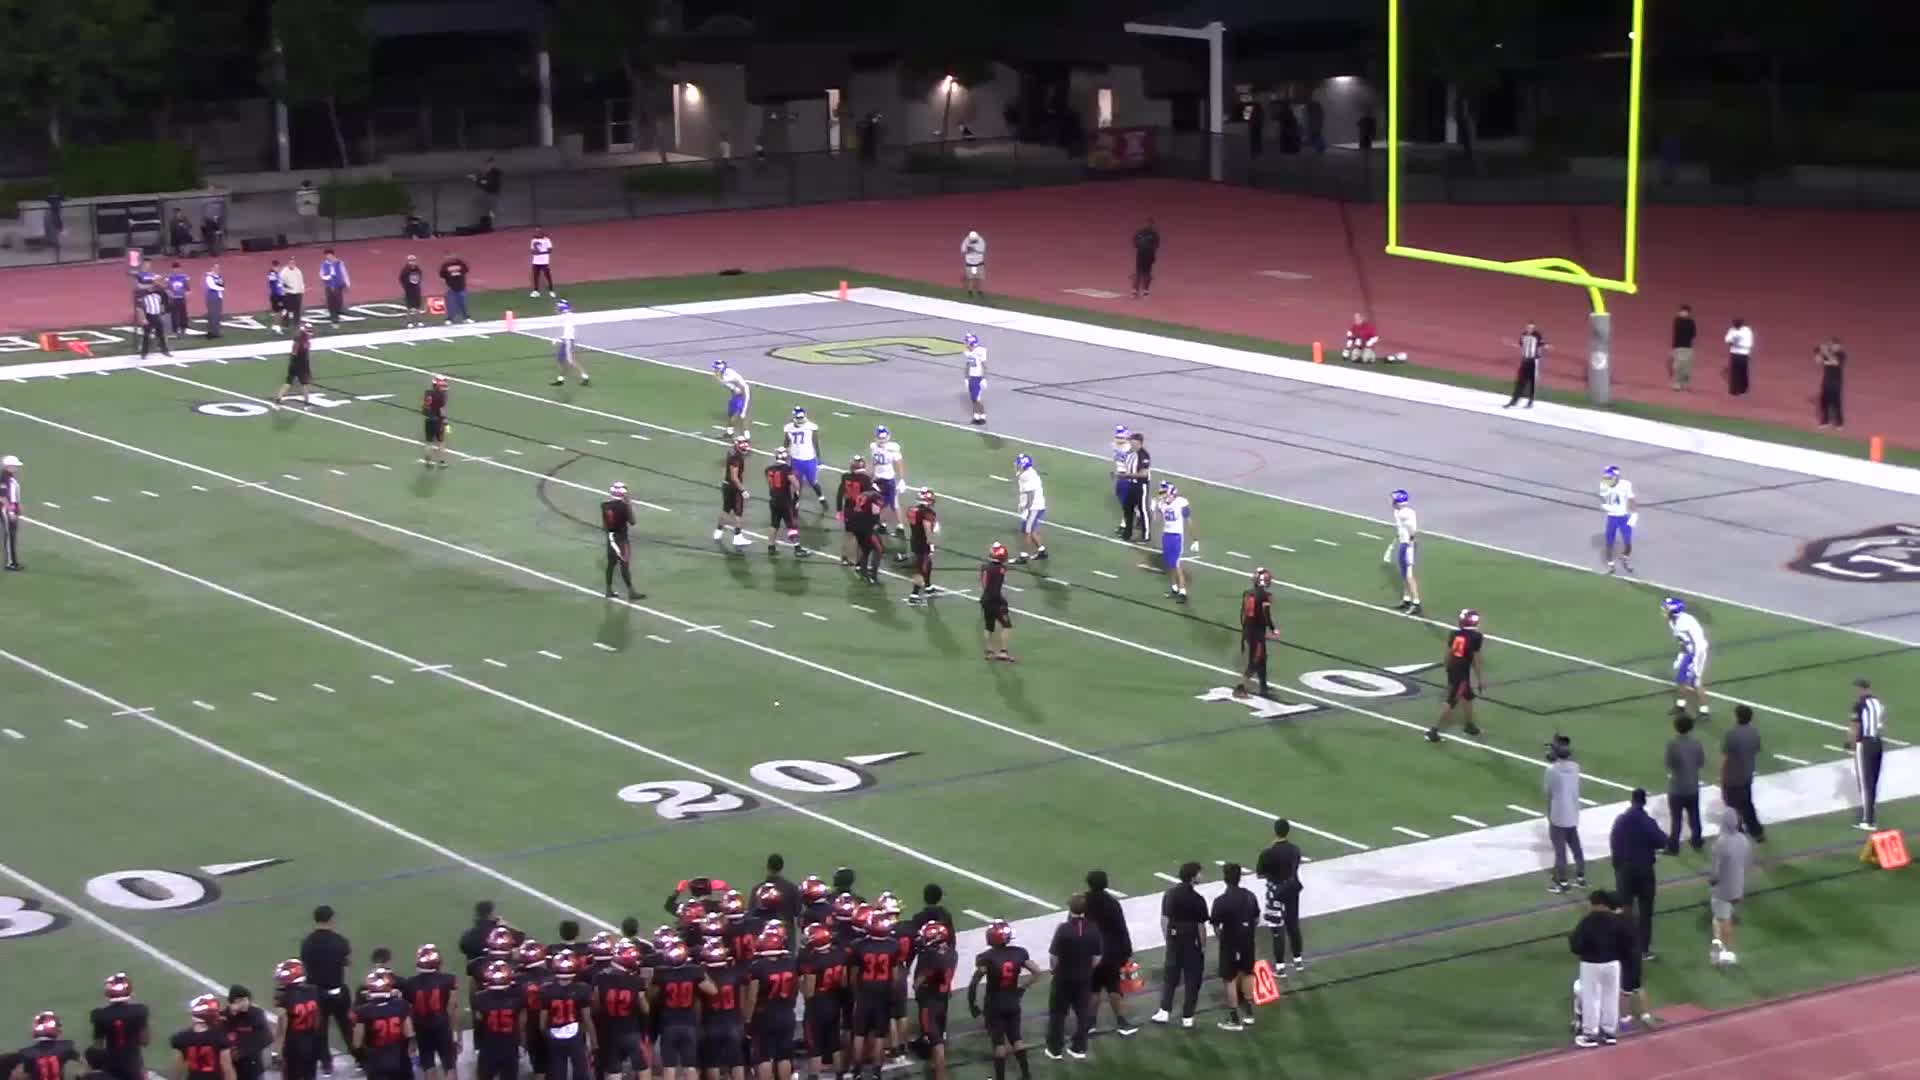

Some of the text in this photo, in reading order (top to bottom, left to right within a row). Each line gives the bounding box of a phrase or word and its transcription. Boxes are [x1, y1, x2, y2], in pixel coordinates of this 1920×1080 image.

[791, 431, 805, 444] 77
[1193, 669, 1415, 719] 10
[617, 759, 872, 821] 20
[862, 951, 889, 982] 33
